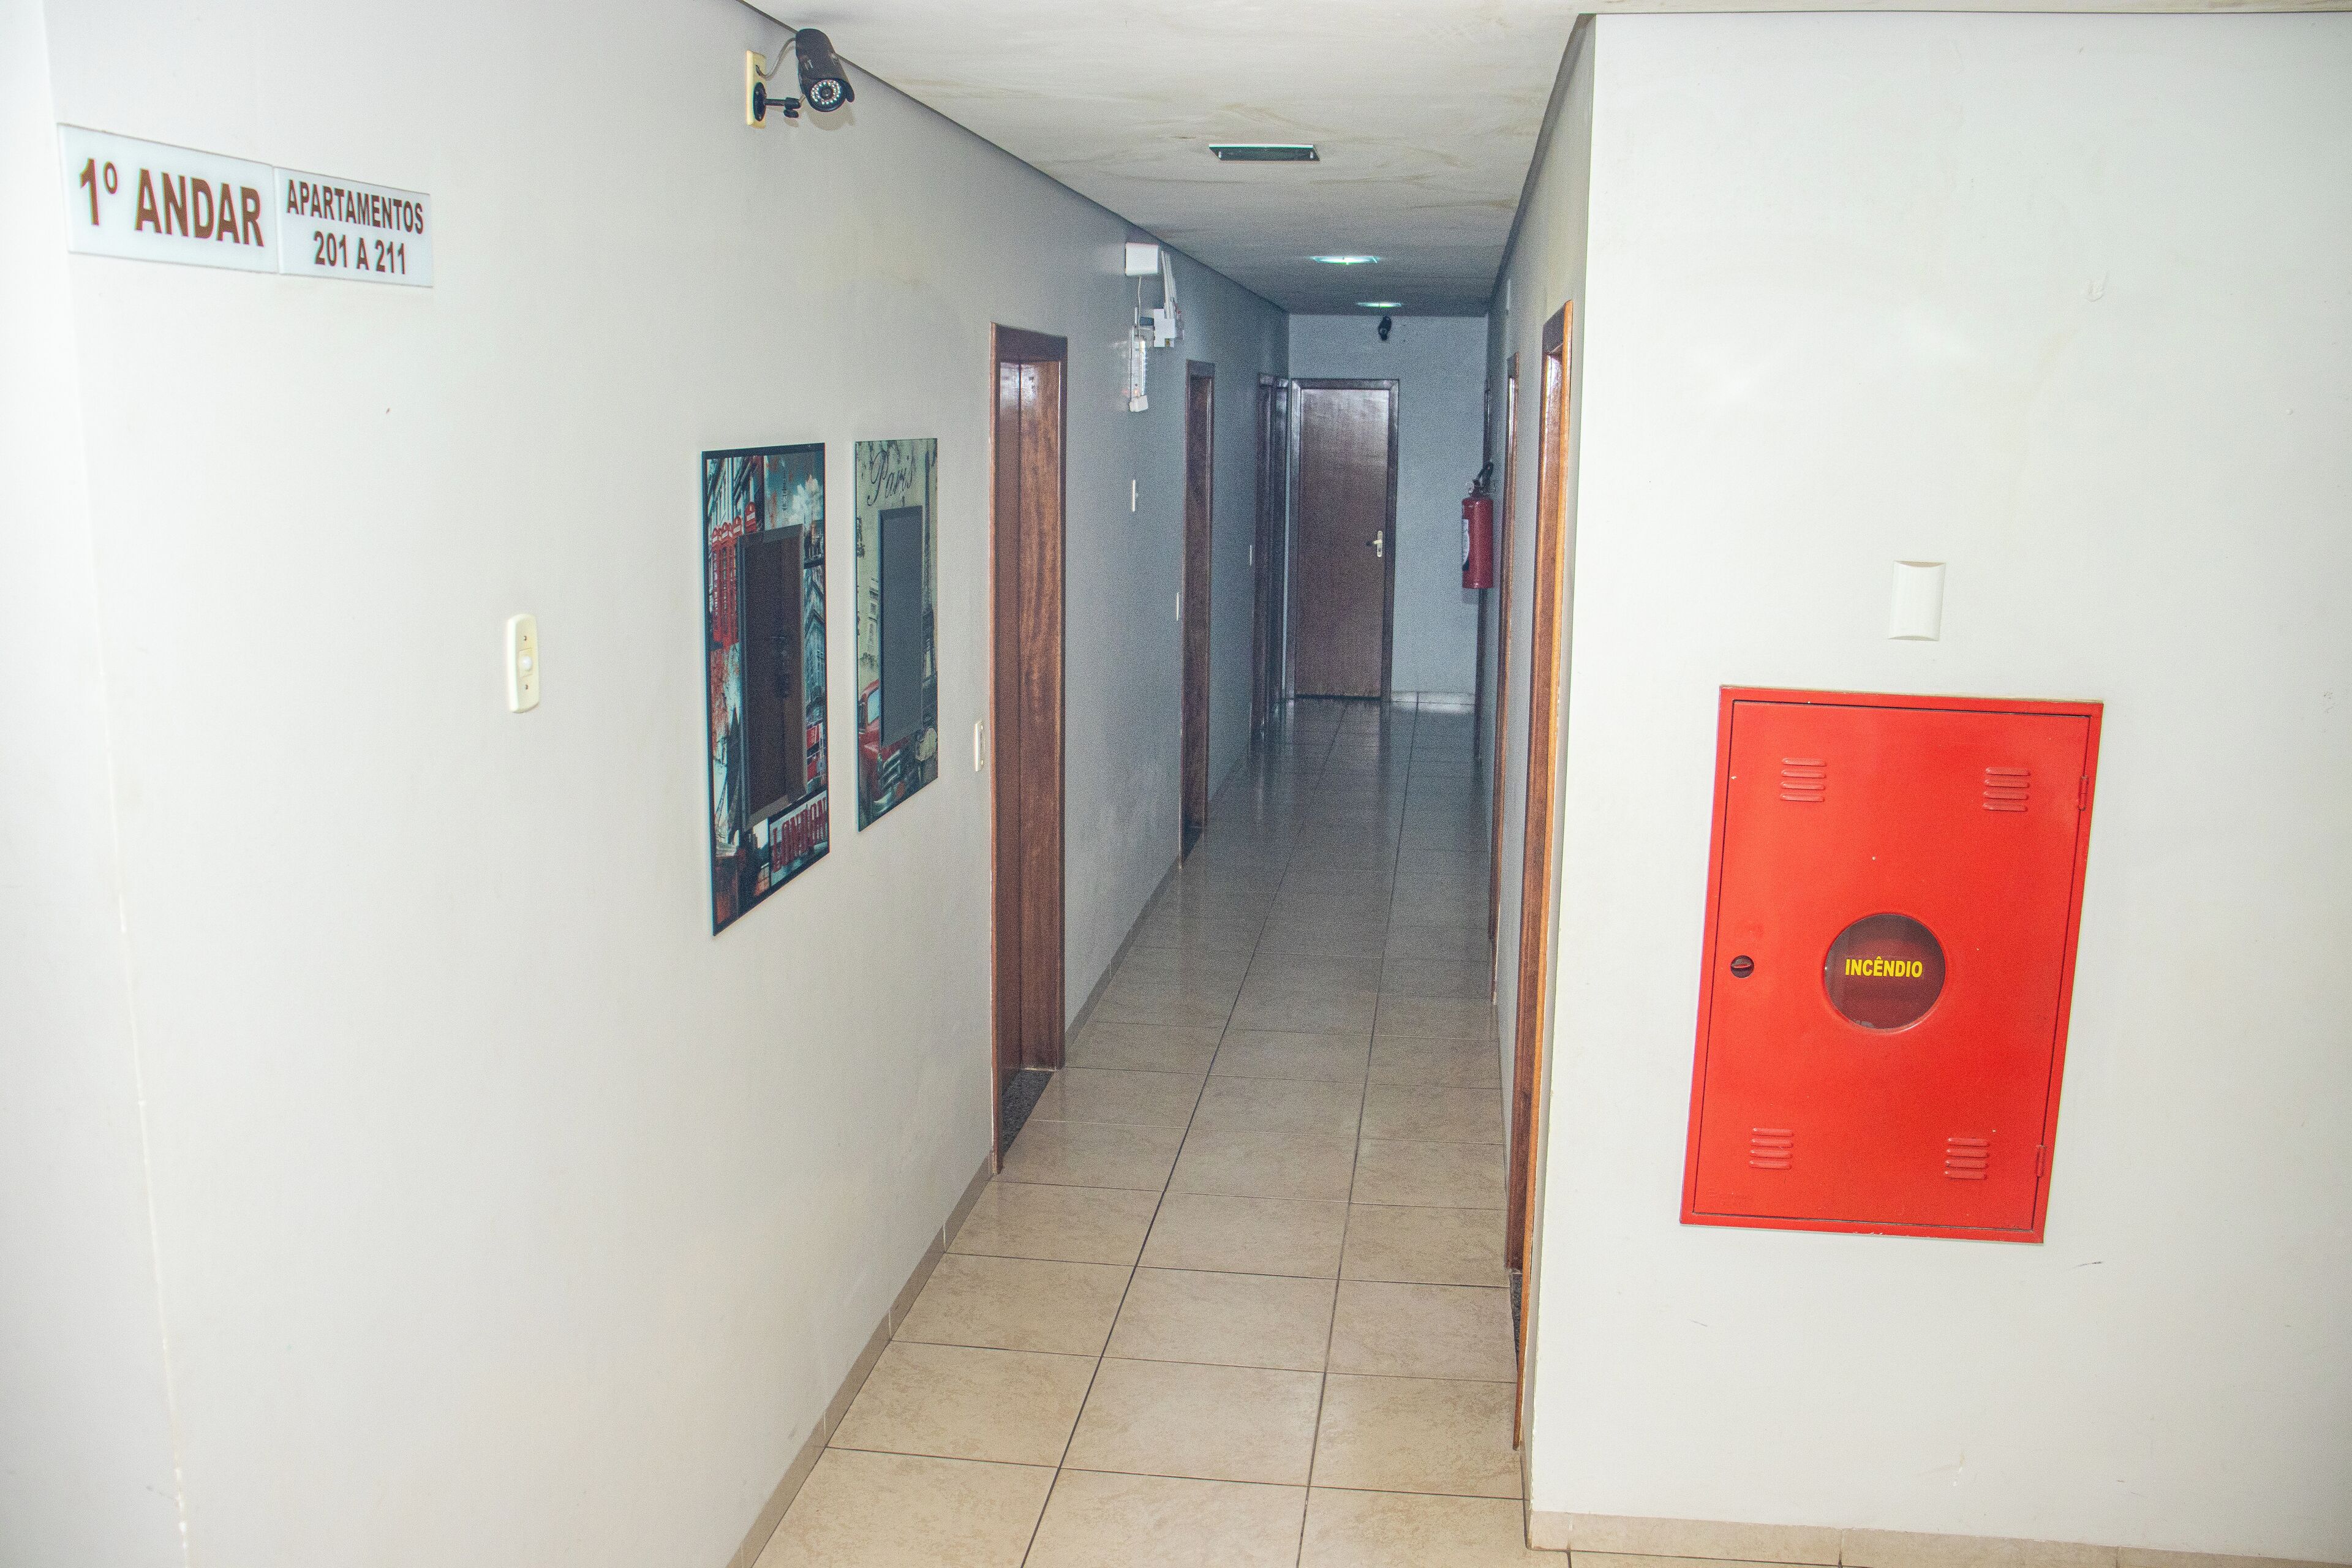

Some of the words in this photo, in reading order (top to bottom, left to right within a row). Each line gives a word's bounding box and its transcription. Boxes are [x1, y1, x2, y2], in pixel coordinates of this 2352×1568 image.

[80, 157, 118, 225] 1º
[134, 168, 264, 247] ANDAR
[287, 179, 424, 234] APARTAMENTOS
[314, 230, 347, 268] 201
[356, 238, 369, 270] A
[375, 239, 405, 274] 211
[867, 449, 913, 506] Paris
[772, 797, 826, 872] LONDON
[1845, 956, 1923, 978] INCÊNDIO
